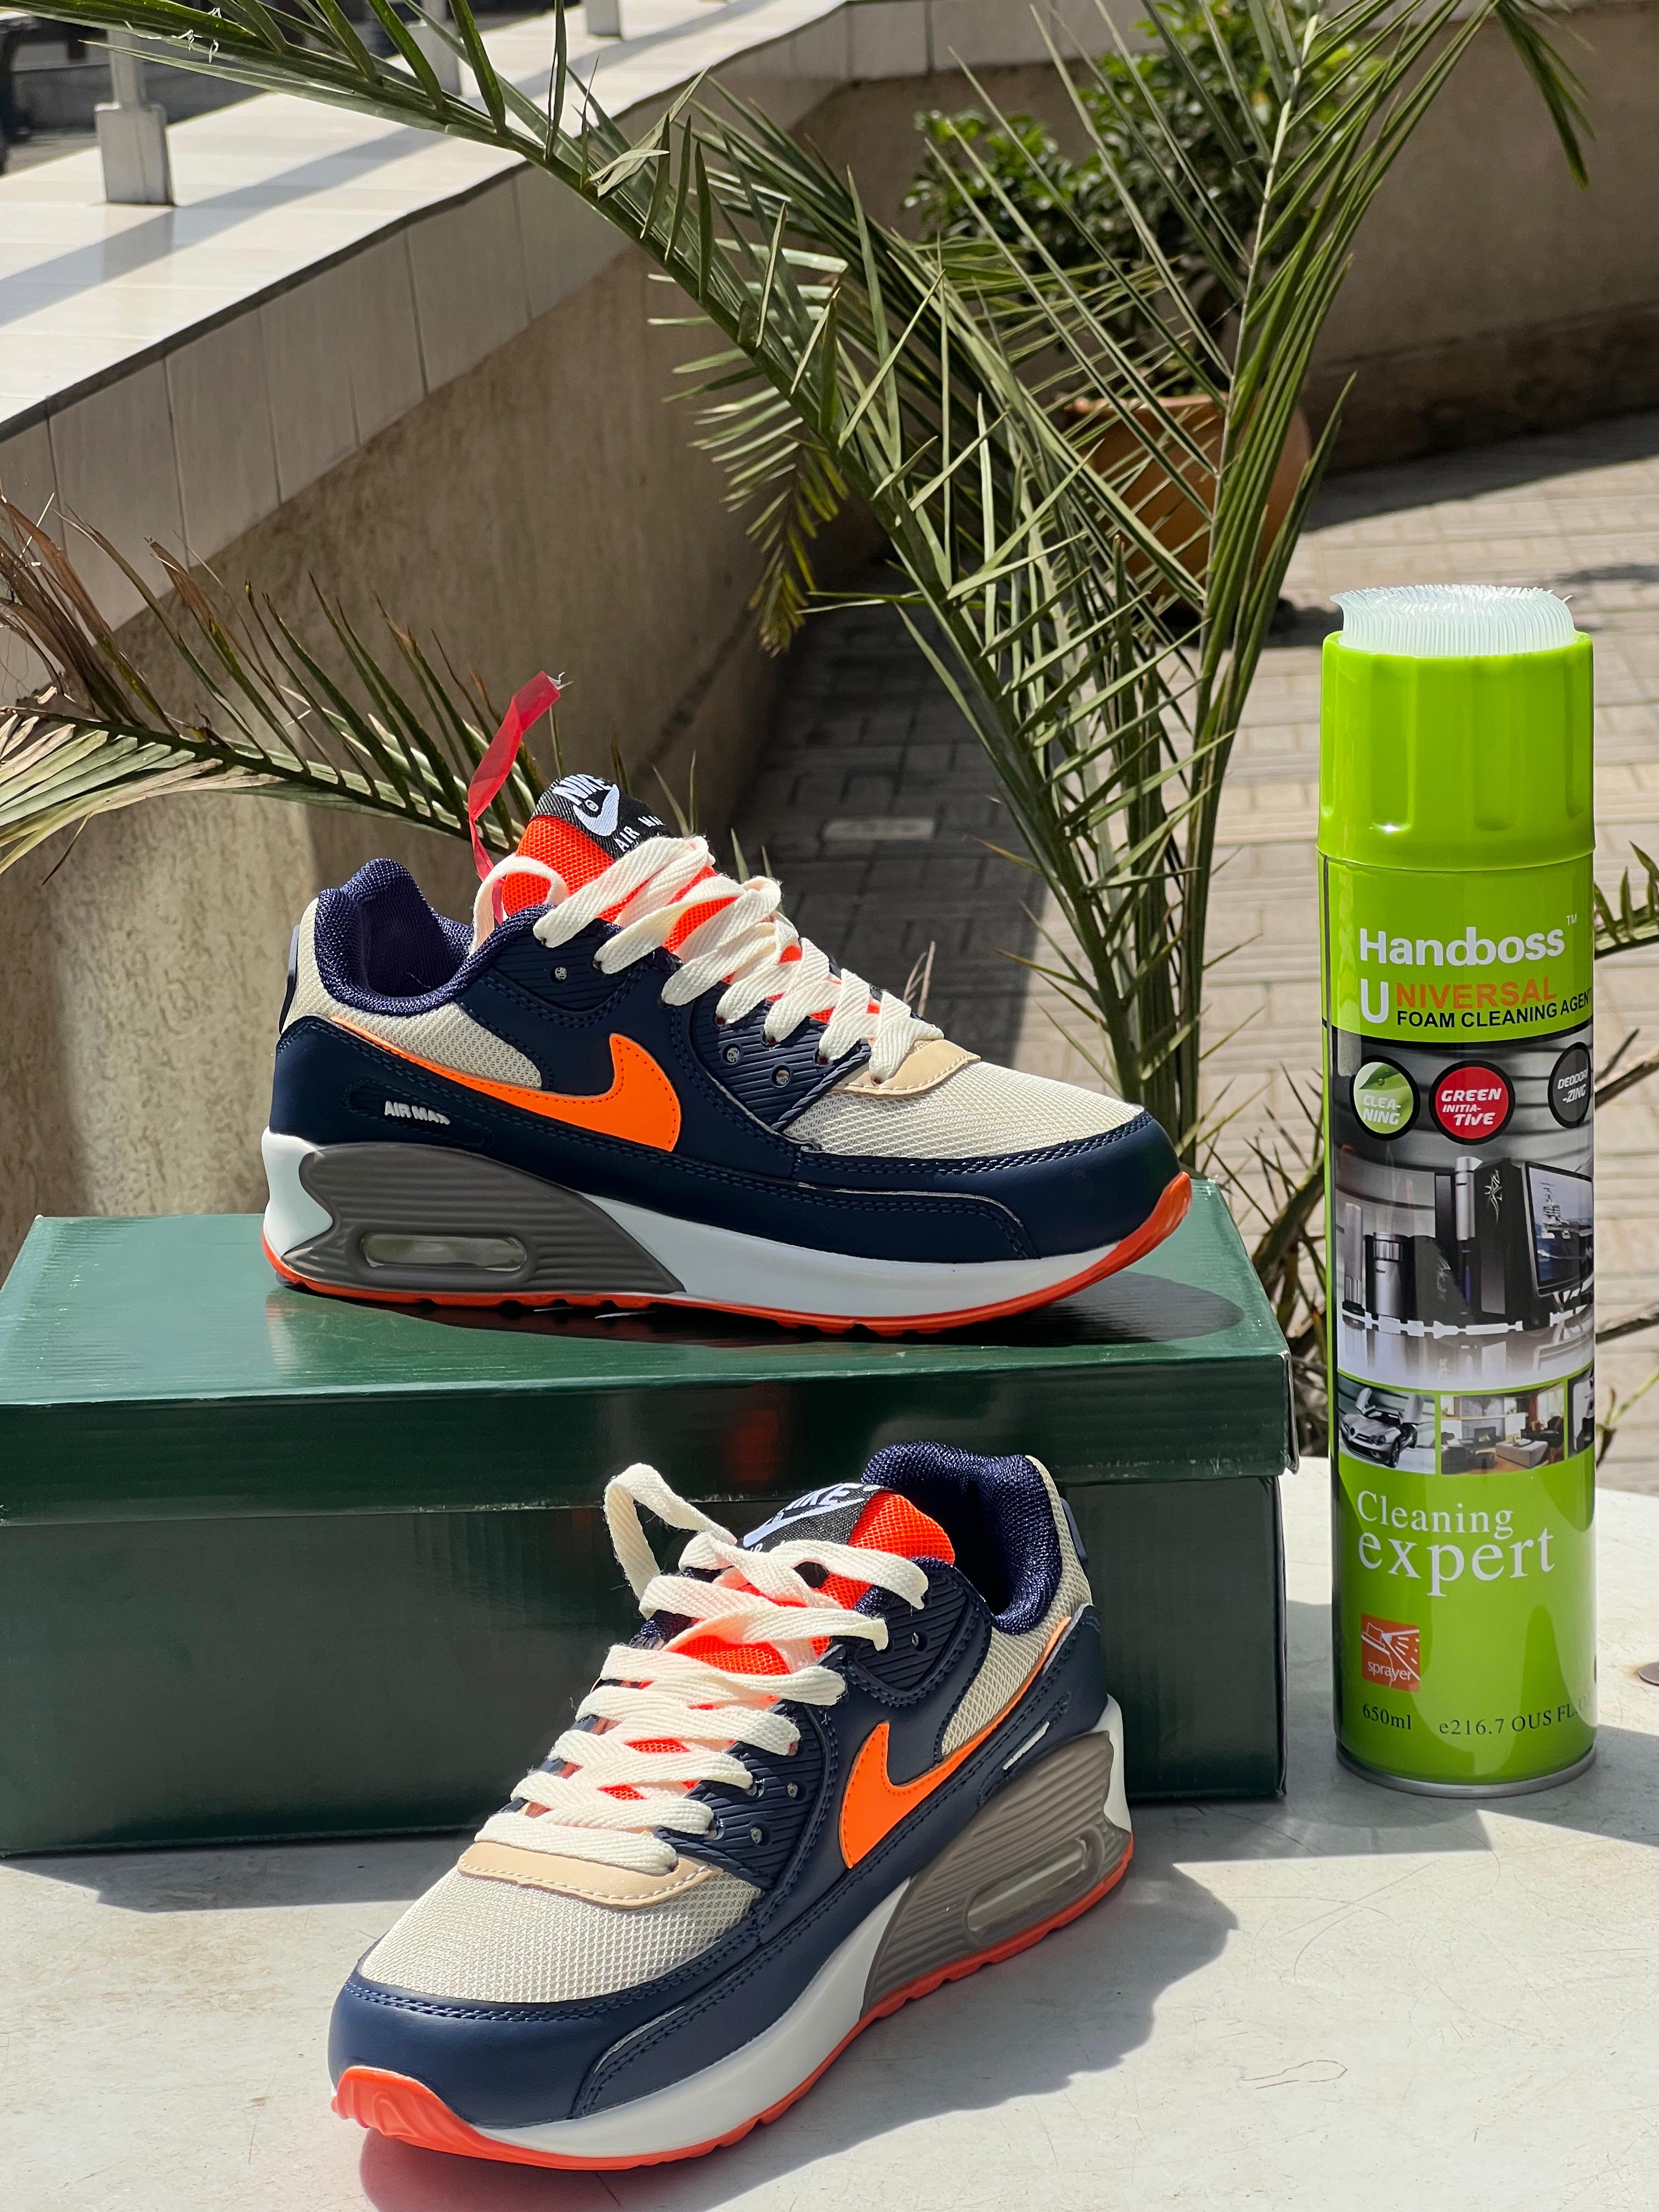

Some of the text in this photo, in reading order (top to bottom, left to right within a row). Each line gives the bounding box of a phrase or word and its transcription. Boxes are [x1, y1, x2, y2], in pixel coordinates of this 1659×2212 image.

[613, 825, 641, 853] AIR
[1359, 926, 1566, 967] Handboss
[1396, 1010, 1455, 1028] FOAM
[1460, 1002, 1558, 1029] CLEANING
[1363, 1094, 1401, 1111] CLEA-
[1441, 1087, 1502, 1103] GREEN
[384, 1100, 412, 1119] AIR
[1362, 1108, 1401, 1126] NING
[1442, 1104, 1482, 1113] INITIA-
[1453, 1112, 1496, 1126] TIVE
[1357, 1490, 1514, 1540] Cleaning
[1358, 1527, 1555, 1598] expert
[1367, 1661, 1413, 1682] sprayer
[1362, 1703, 1412, 1730] 650ml
[1511, 1709, 1552, 1731] OUS
